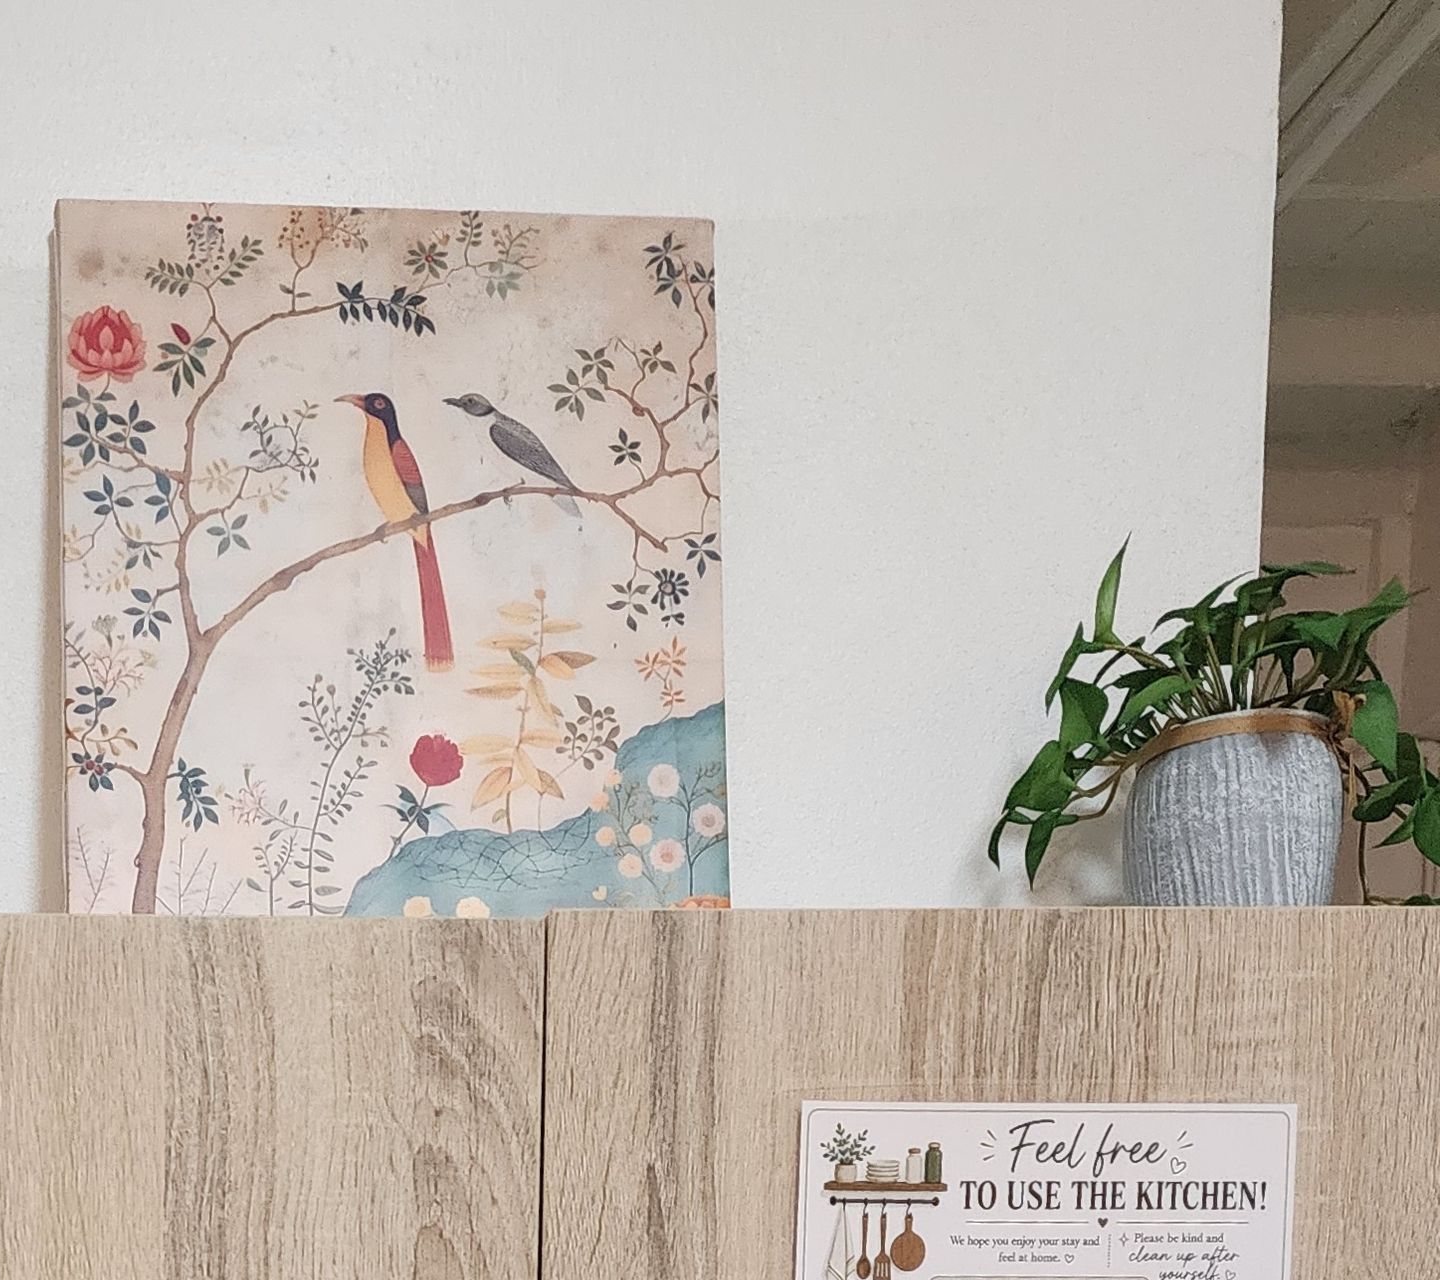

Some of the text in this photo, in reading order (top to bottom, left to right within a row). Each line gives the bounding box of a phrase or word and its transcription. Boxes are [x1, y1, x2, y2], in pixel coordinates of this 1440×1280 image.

[1009, 1119, 1168, 1178] Feel free
[959, 1180, 1267, 1211] TO USE THE KITCHEN!
[950, 1235, 1100, 1249] We hope you enjoy your stay and
[1134, 1232, 1224, 1244] Please be kind and
[998, 1252, 1061, 1262] feel at home.
[1128, 1246, 1240, 1268] clean up after
